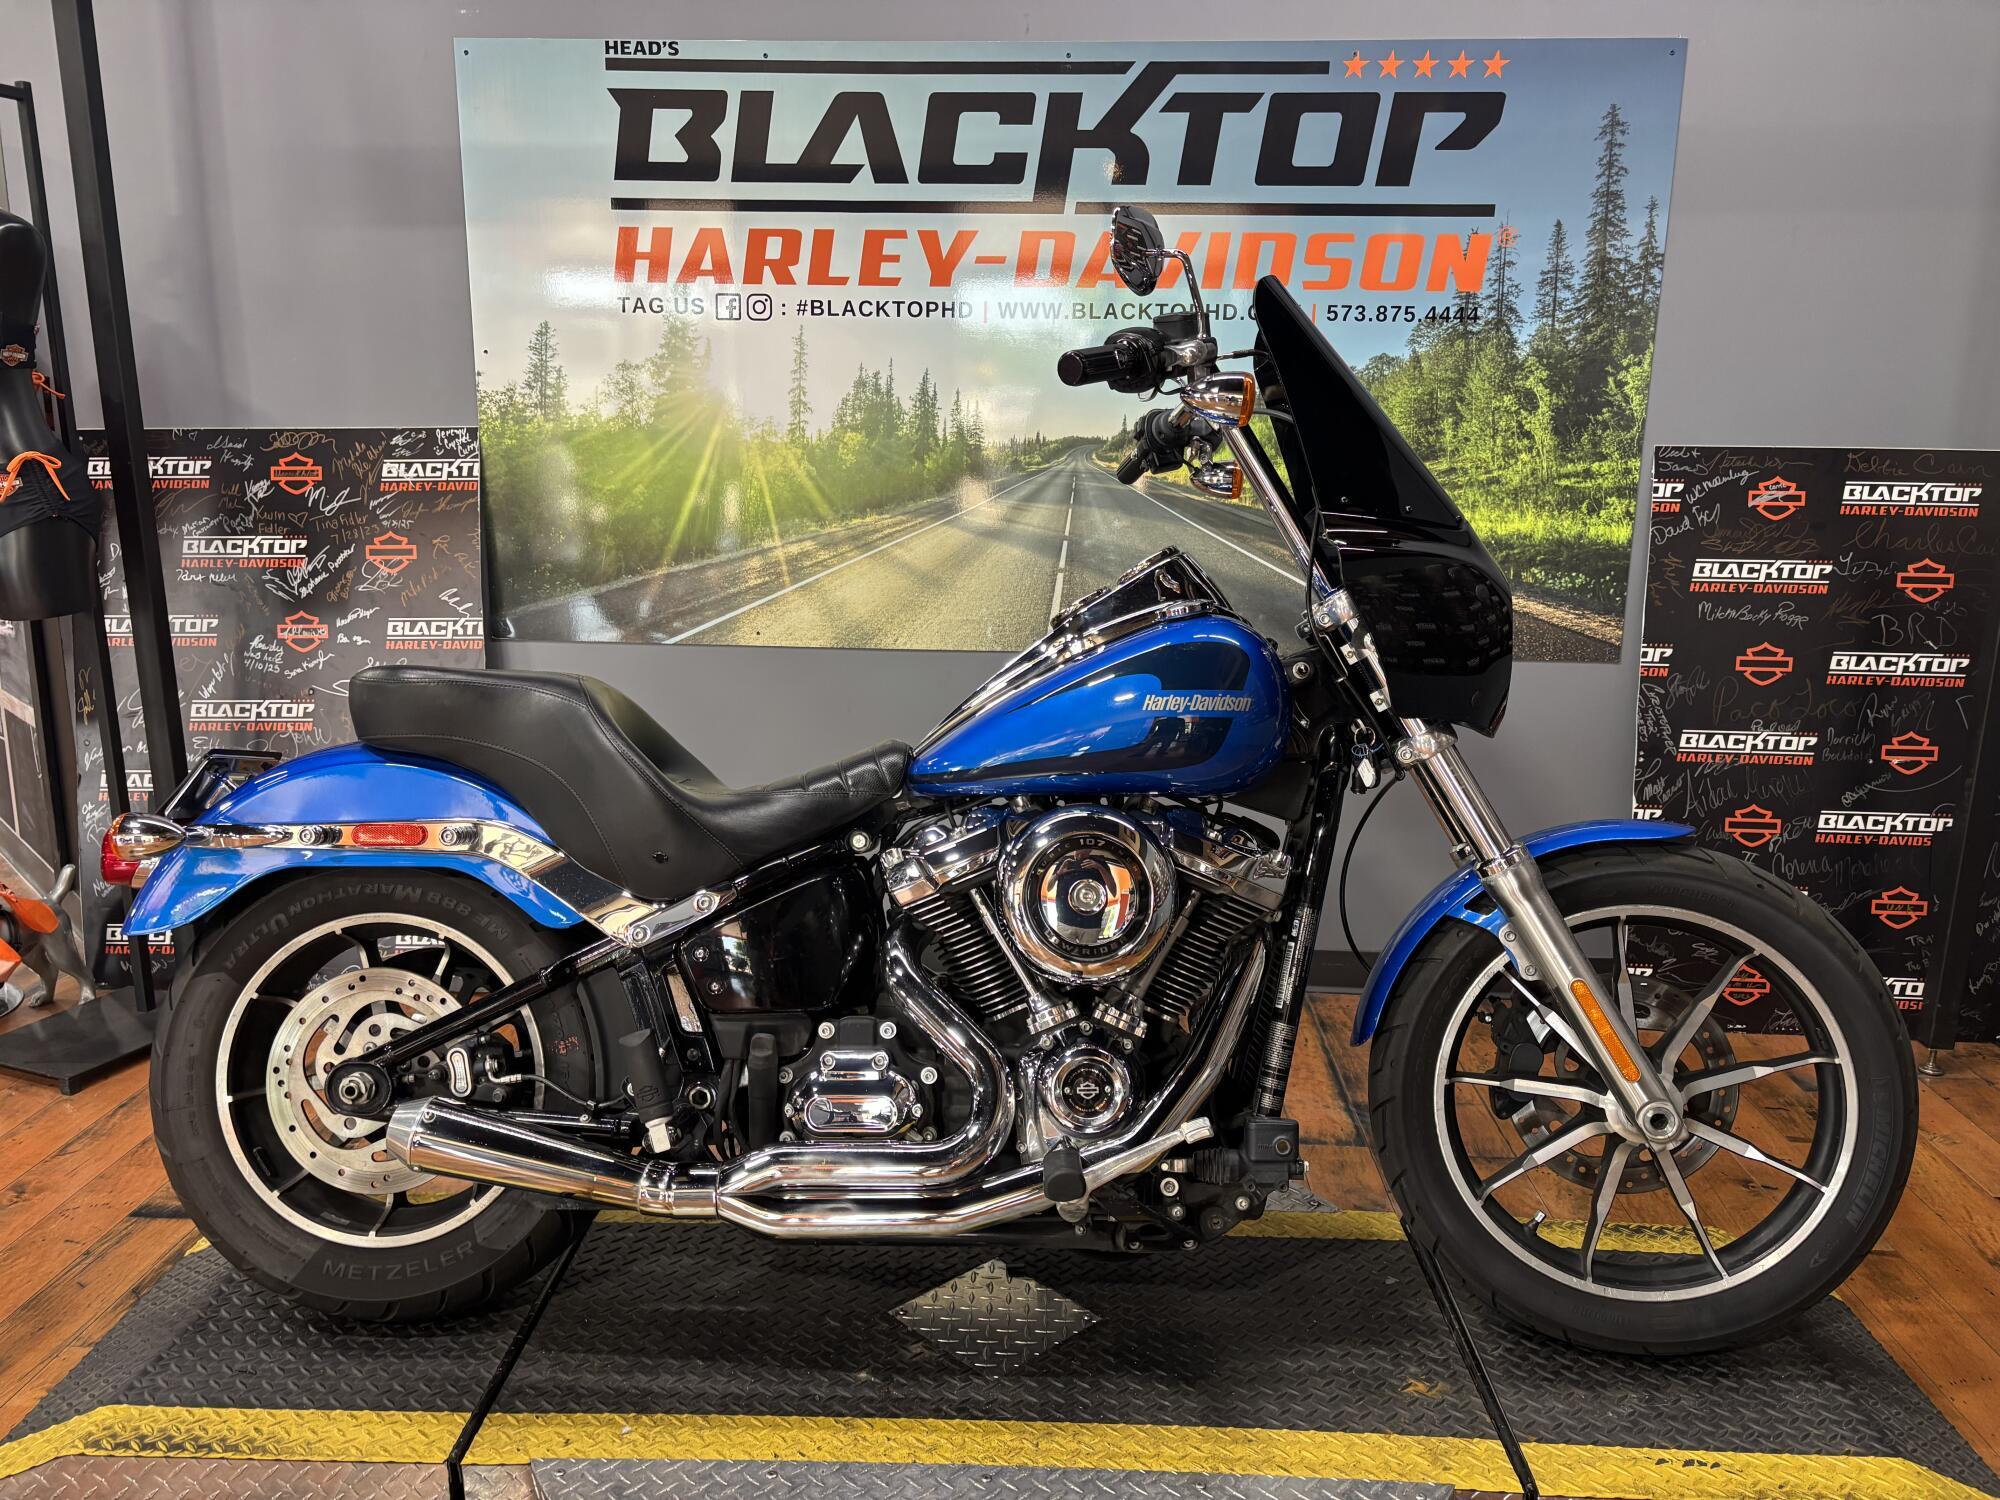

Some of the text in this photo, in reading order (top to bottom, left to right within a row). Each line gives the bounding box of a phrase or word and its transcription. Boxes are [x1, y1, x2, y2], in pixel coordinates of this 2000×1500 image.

[604, 40, 680, 56] HEAD'S
[607, 84, 1507, 201] BLACKTOP
[613, 226, 1492, 292] HARLEY-DAVIDSON
[618, 296, 665, 314] TAG
[674, 297, 704, 315] US
[796, 299, 972, 319] #BLACKTOPHD
[1326, 304, 1480, 323] 573.875.4444
[1843, 485, 1983, 505] BLACKTOP
[1839, 505, 1980, 517] HARLEY-DAVIDSON
[182, 539, 308, 557] BLACKTOP
[181, 559, 306, 568] HARLEY-DAVIDSON
[1692, 562, 1833, 583] BLACKTOP
[1689, 582, 1829, 594] HARLEY-DAVIDSON
[1829, 655, 1970, 675] BLACKTOP
[1826, 675, 1965, 687] HARLEY-DAVIDSON
[190, 703, 315, 721] BLACKTOP
[1142, 693, 1252, 713] Harley-Davidson
[188, 721, 313, 732] HARLEY-DAVIDSON
[1679, 733, 1818, 753] BLACKTOP
[1676, 753, 1814, 765] HARLEY-DAVIDSON
[1817, 814, 1954, 834] BLACKTOP
[1079, 838, 1106, 848] 107
[287, 880, 424, 918] MARATHON
[321, 1240, 475, 1282] METZELER
